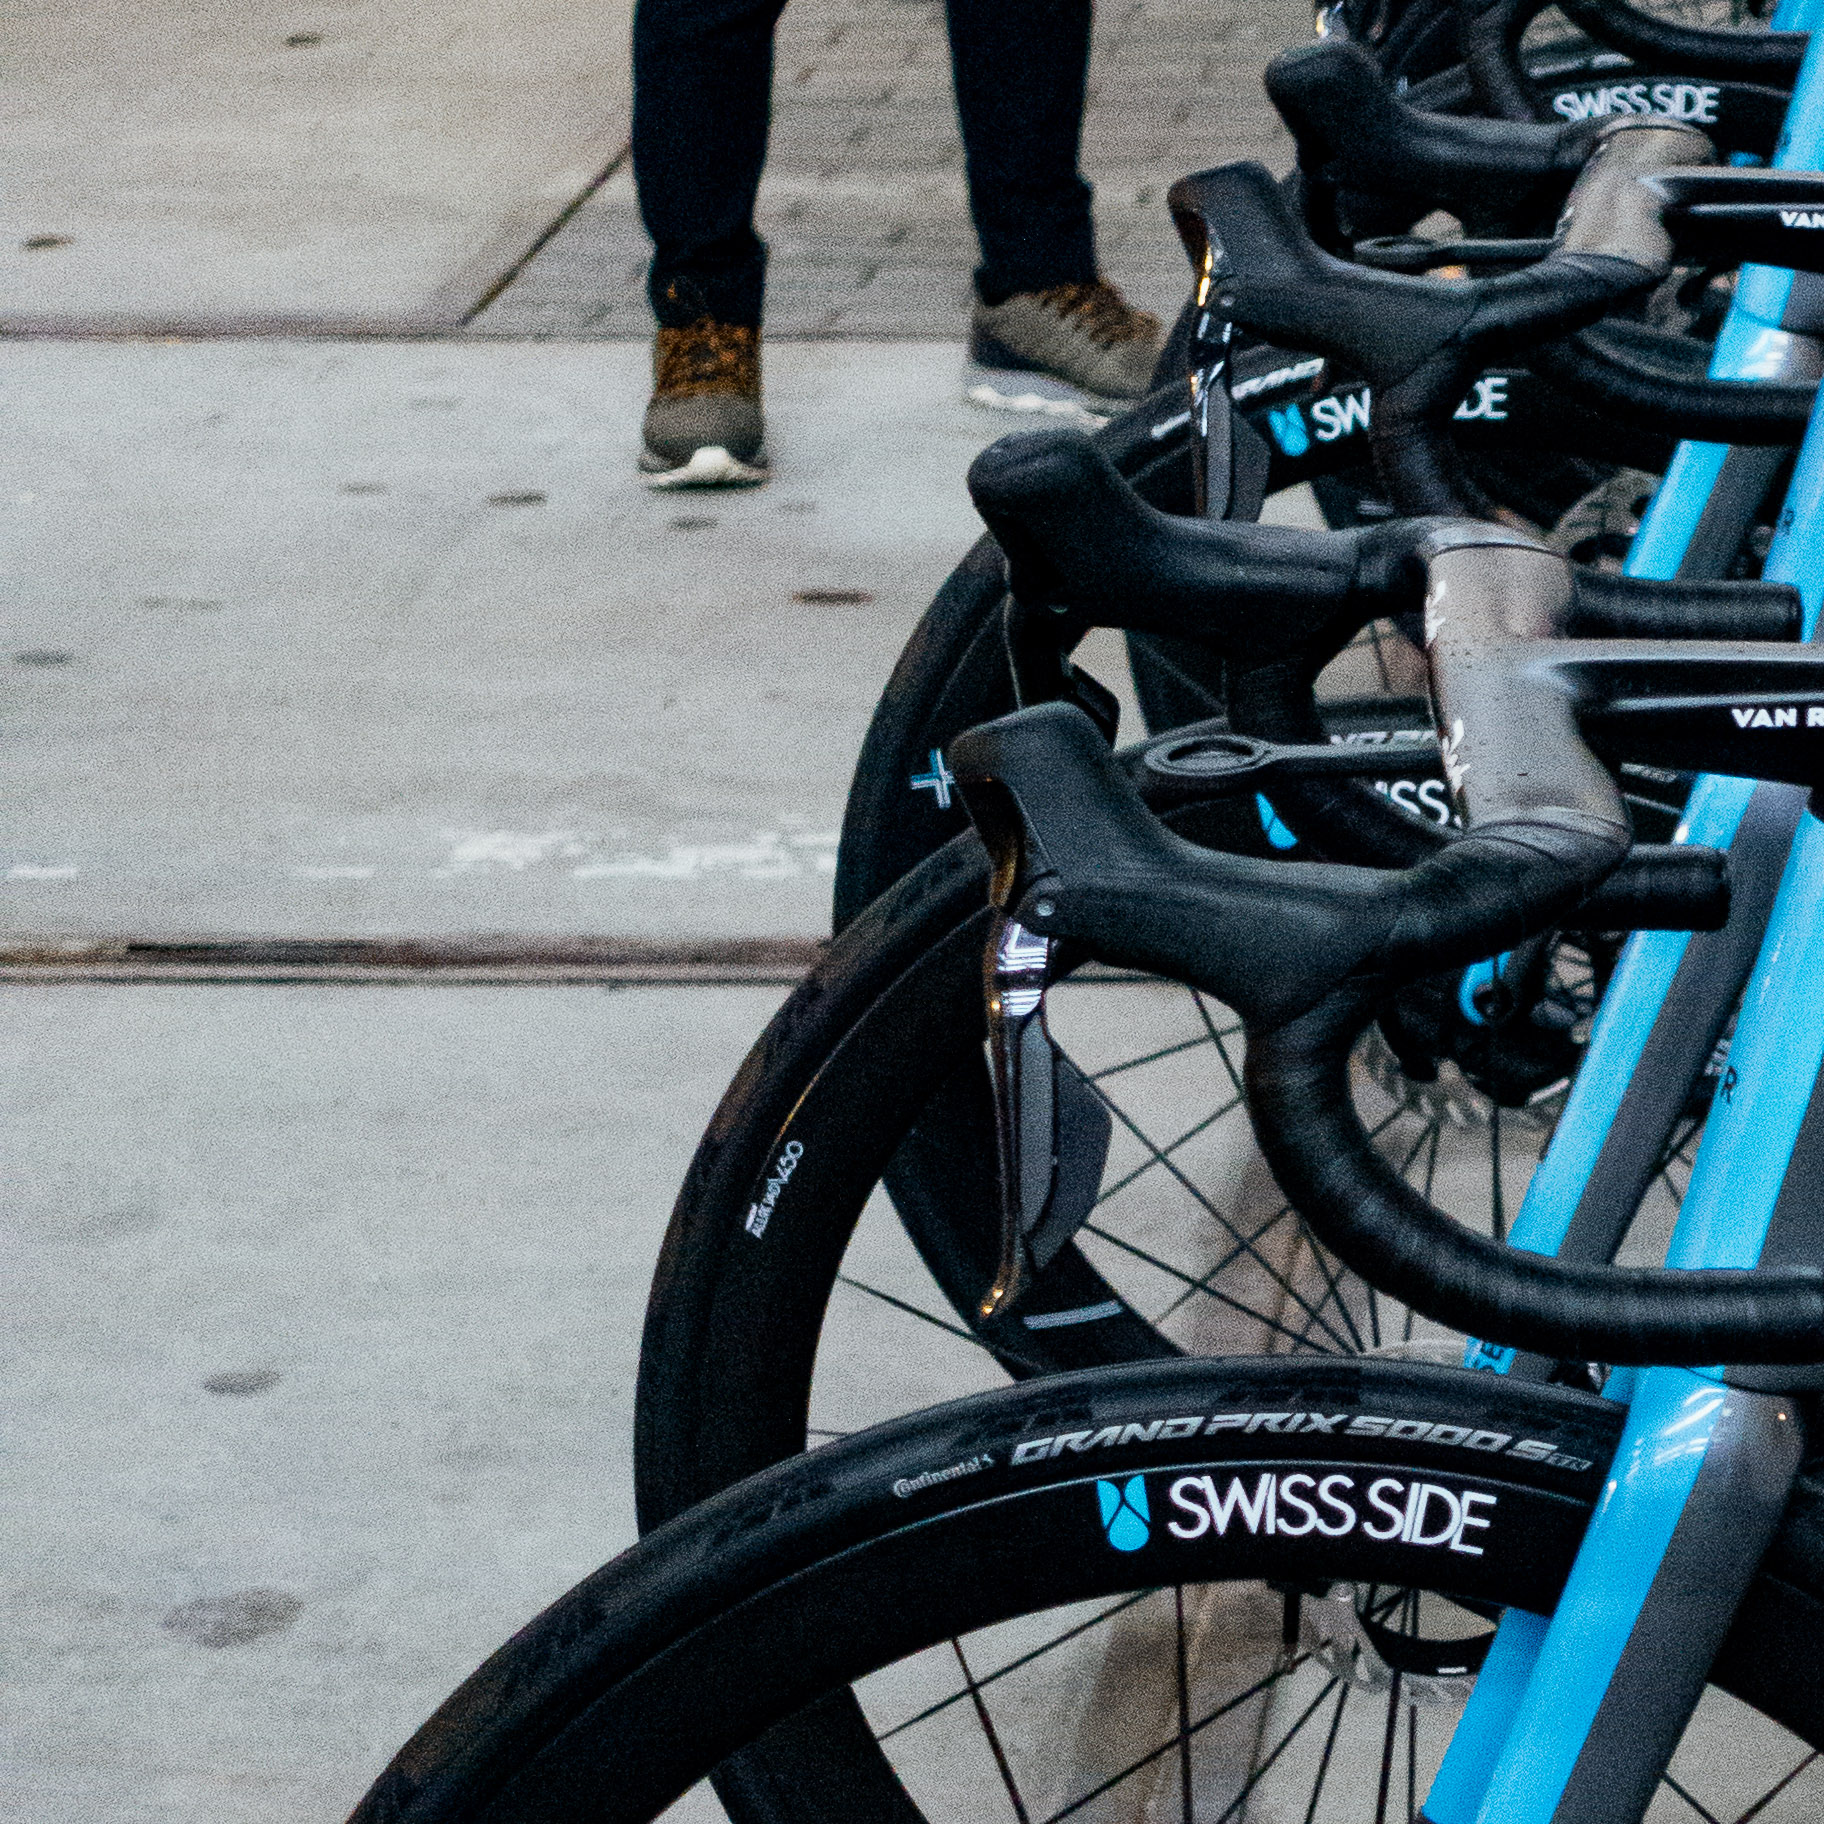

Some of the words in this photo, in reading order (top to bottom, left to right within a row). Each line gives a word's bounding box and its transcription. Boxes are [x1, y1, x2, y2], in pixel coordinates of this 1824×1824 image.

[1553, 84, 1651, 122] SWISS
[1731, 707, 1798, 728] VAN
[1011, 1415, 1205, 1467] GRAND
[1204, 1412, 1349, 1436] PRIX
[1343, 1414, 1513, 1453] 5000
[1168, 1472, 1356, 1540] SWISS
[1363, 1478, 1498, 1556] SIDE
